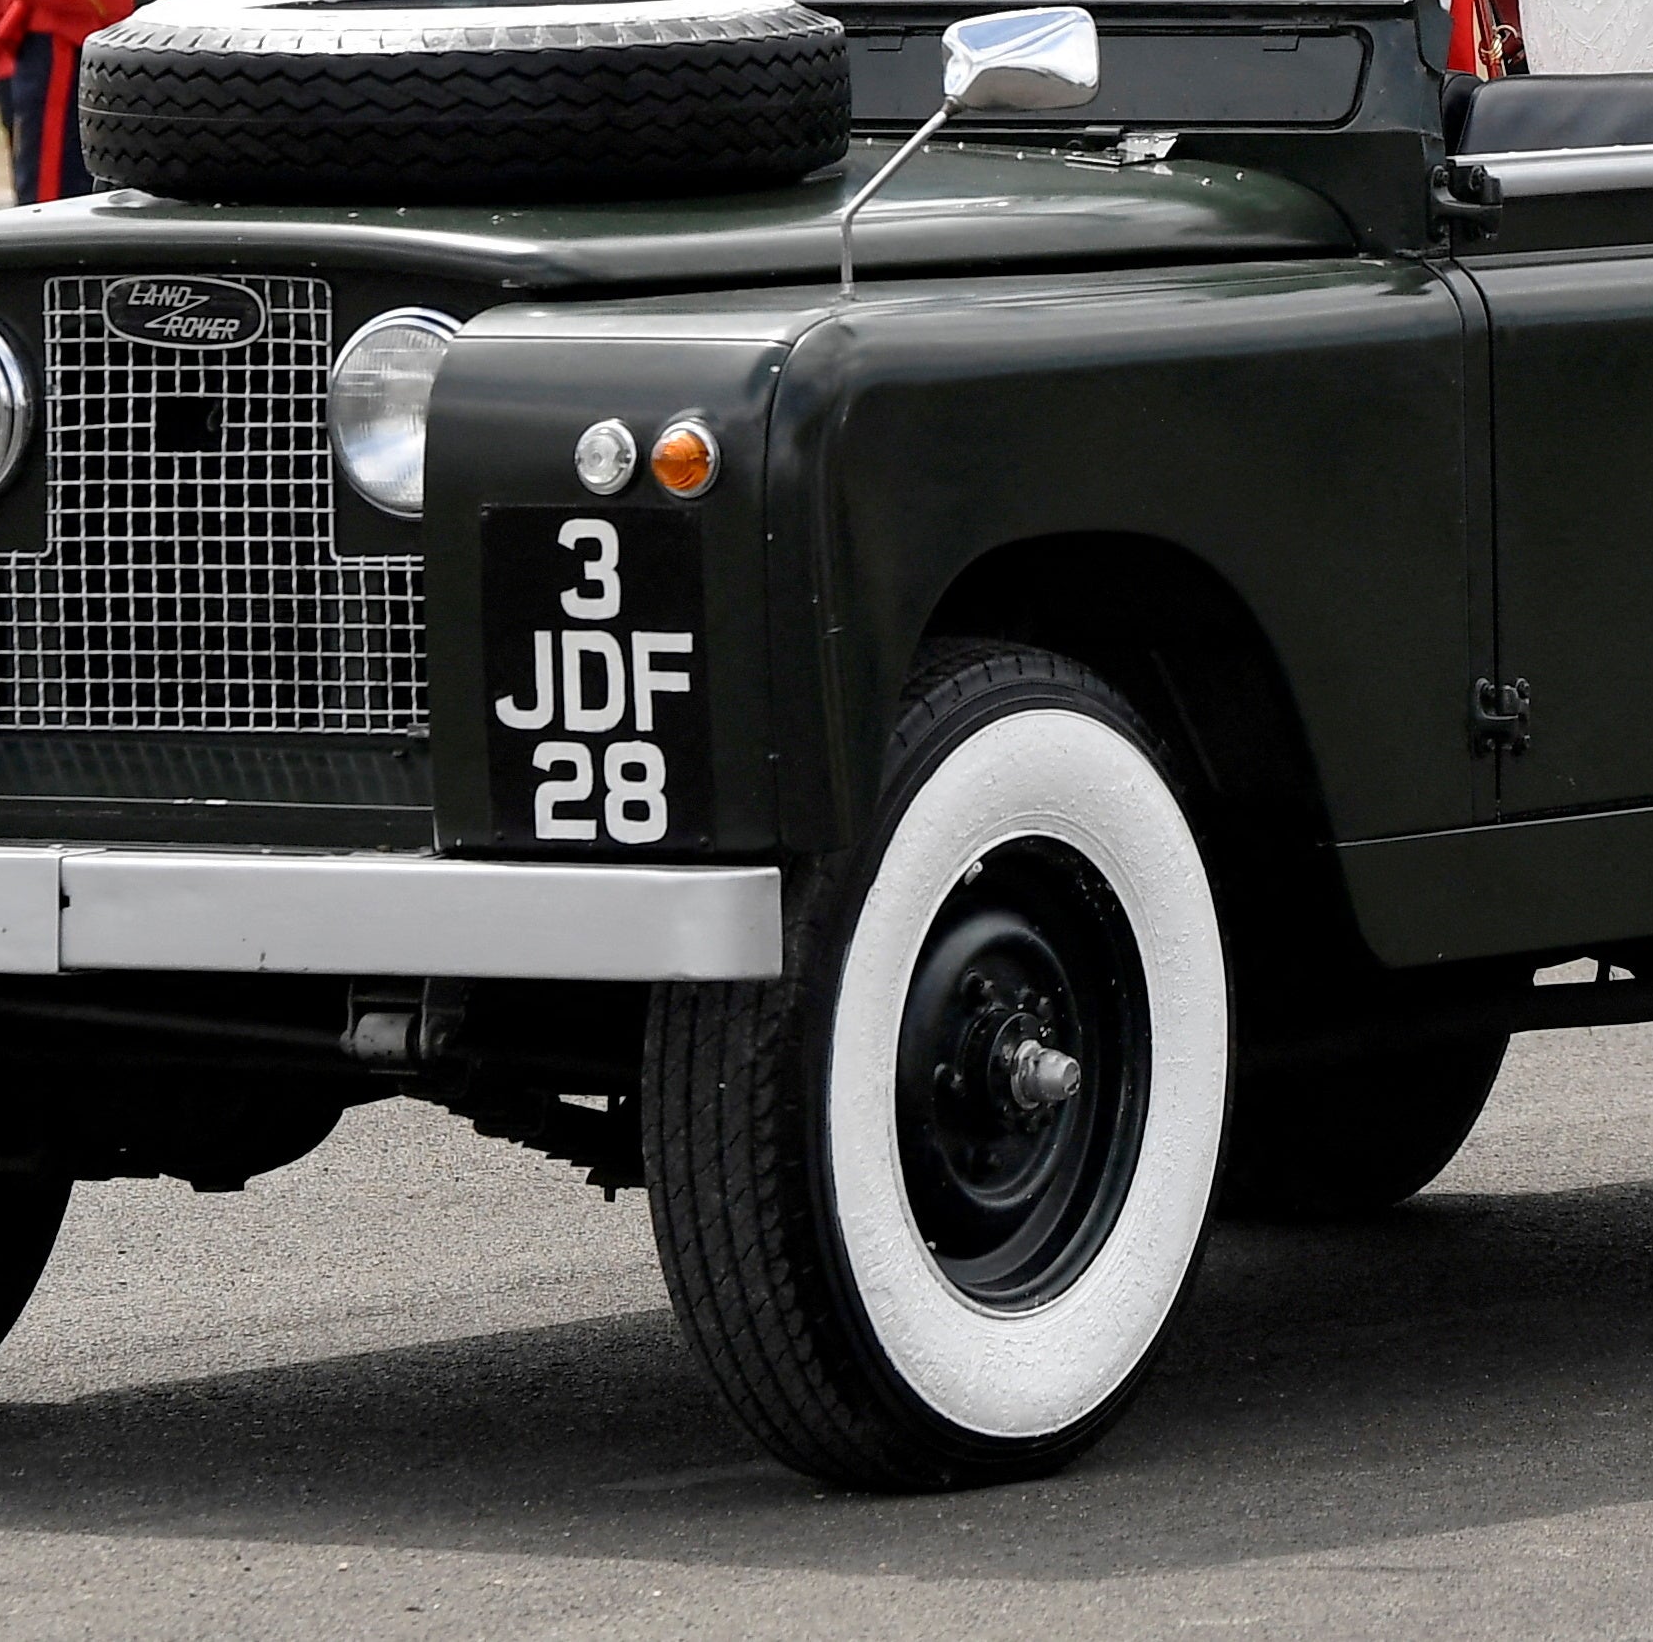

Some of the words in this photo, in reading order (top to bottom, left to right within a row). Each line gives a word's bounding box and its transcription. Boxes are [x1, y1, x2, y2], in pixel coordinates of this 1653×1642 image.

[127, 282, 192, 307] LAND
[163, 315, 241, 340] ROVER
[557, 518, 621, 620] 3
[495, 630, 693, 733] JDF
[532, 740, 668, 844] 28
